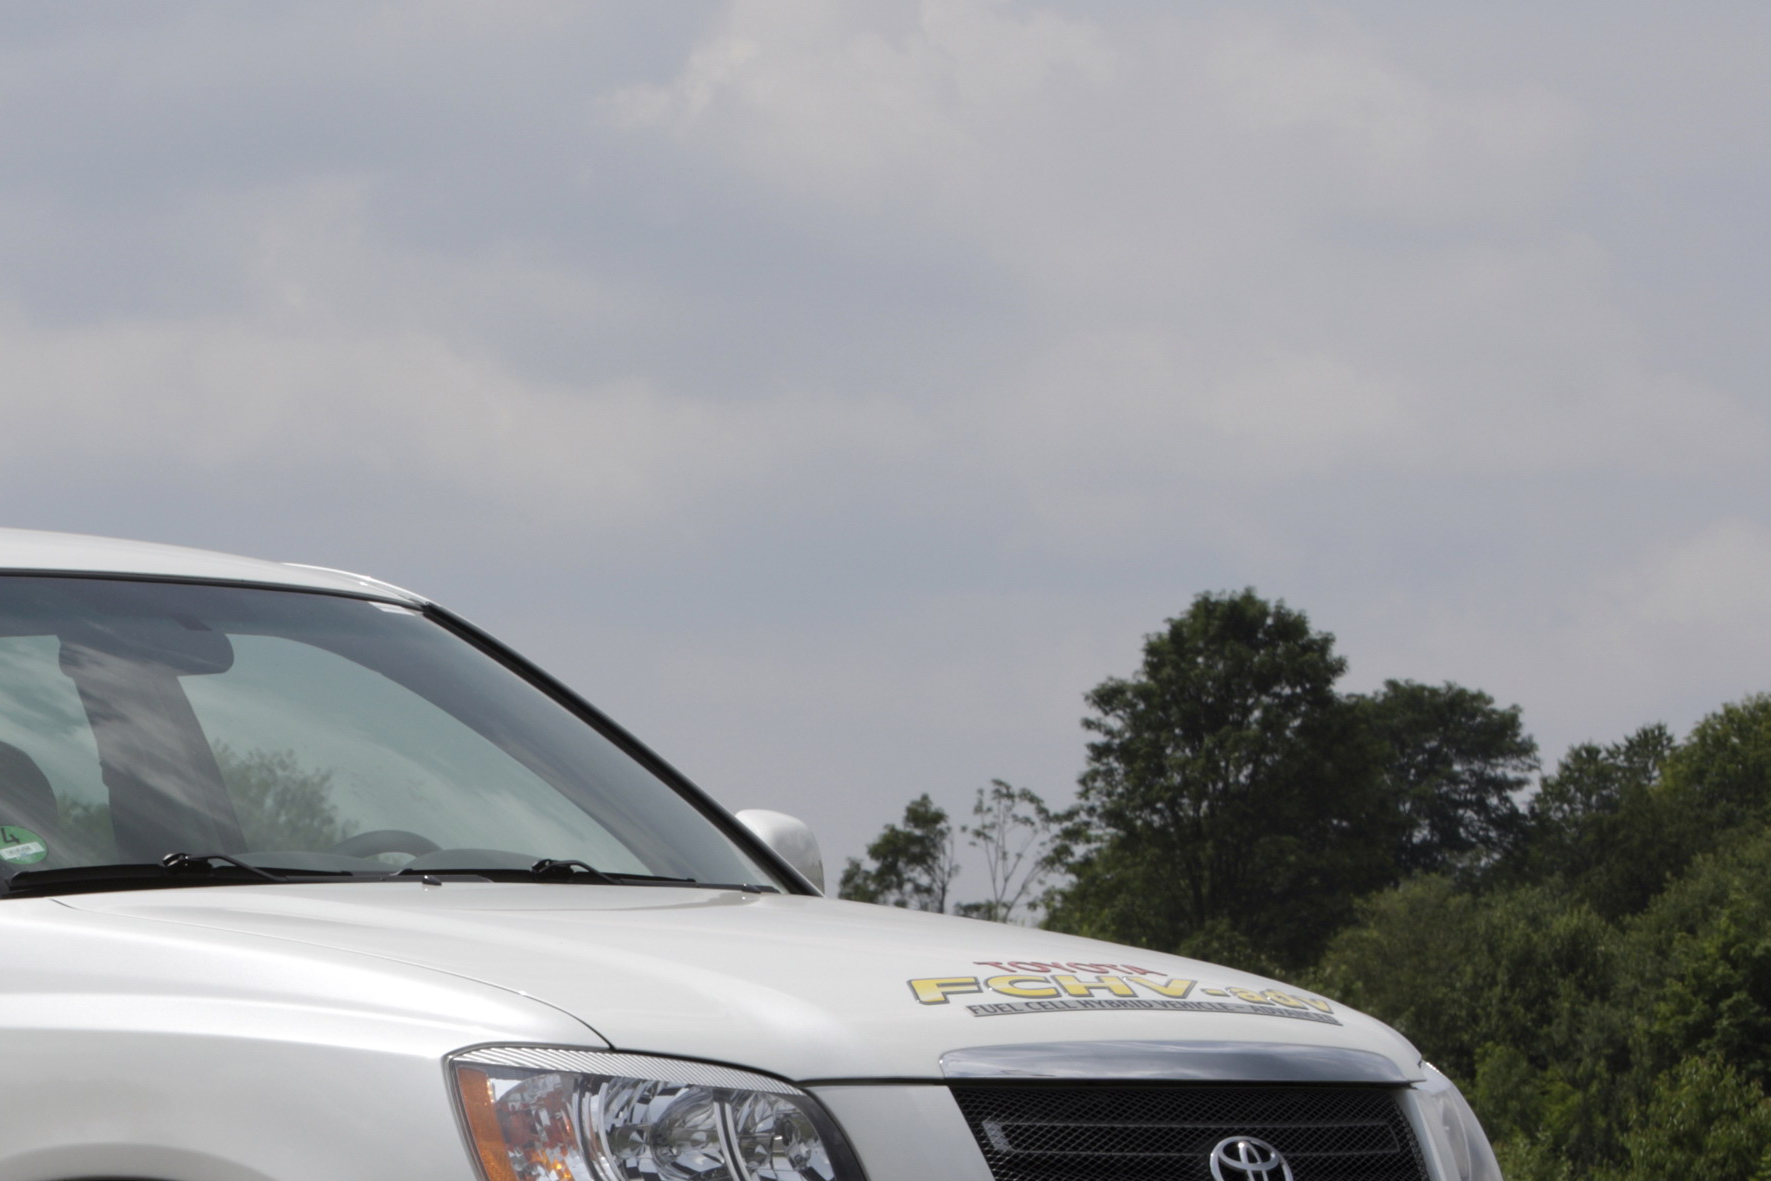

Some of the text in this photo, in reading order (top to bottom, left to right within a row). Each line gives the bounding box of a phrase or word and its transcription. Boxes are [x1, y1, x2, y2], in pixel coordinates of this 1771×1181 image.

[972, 961, 1169, 977] TOYOTA
[906, 974, 1335, 1015] FCHV-adv
[969, 1003, 1021, 1016] FUEL
[1025, 1000, 1078, 1011] CELL
[1077, 999, 1155, 1010] HYBRID
[1156, 1000, 1235, 1011] VEHICLE
